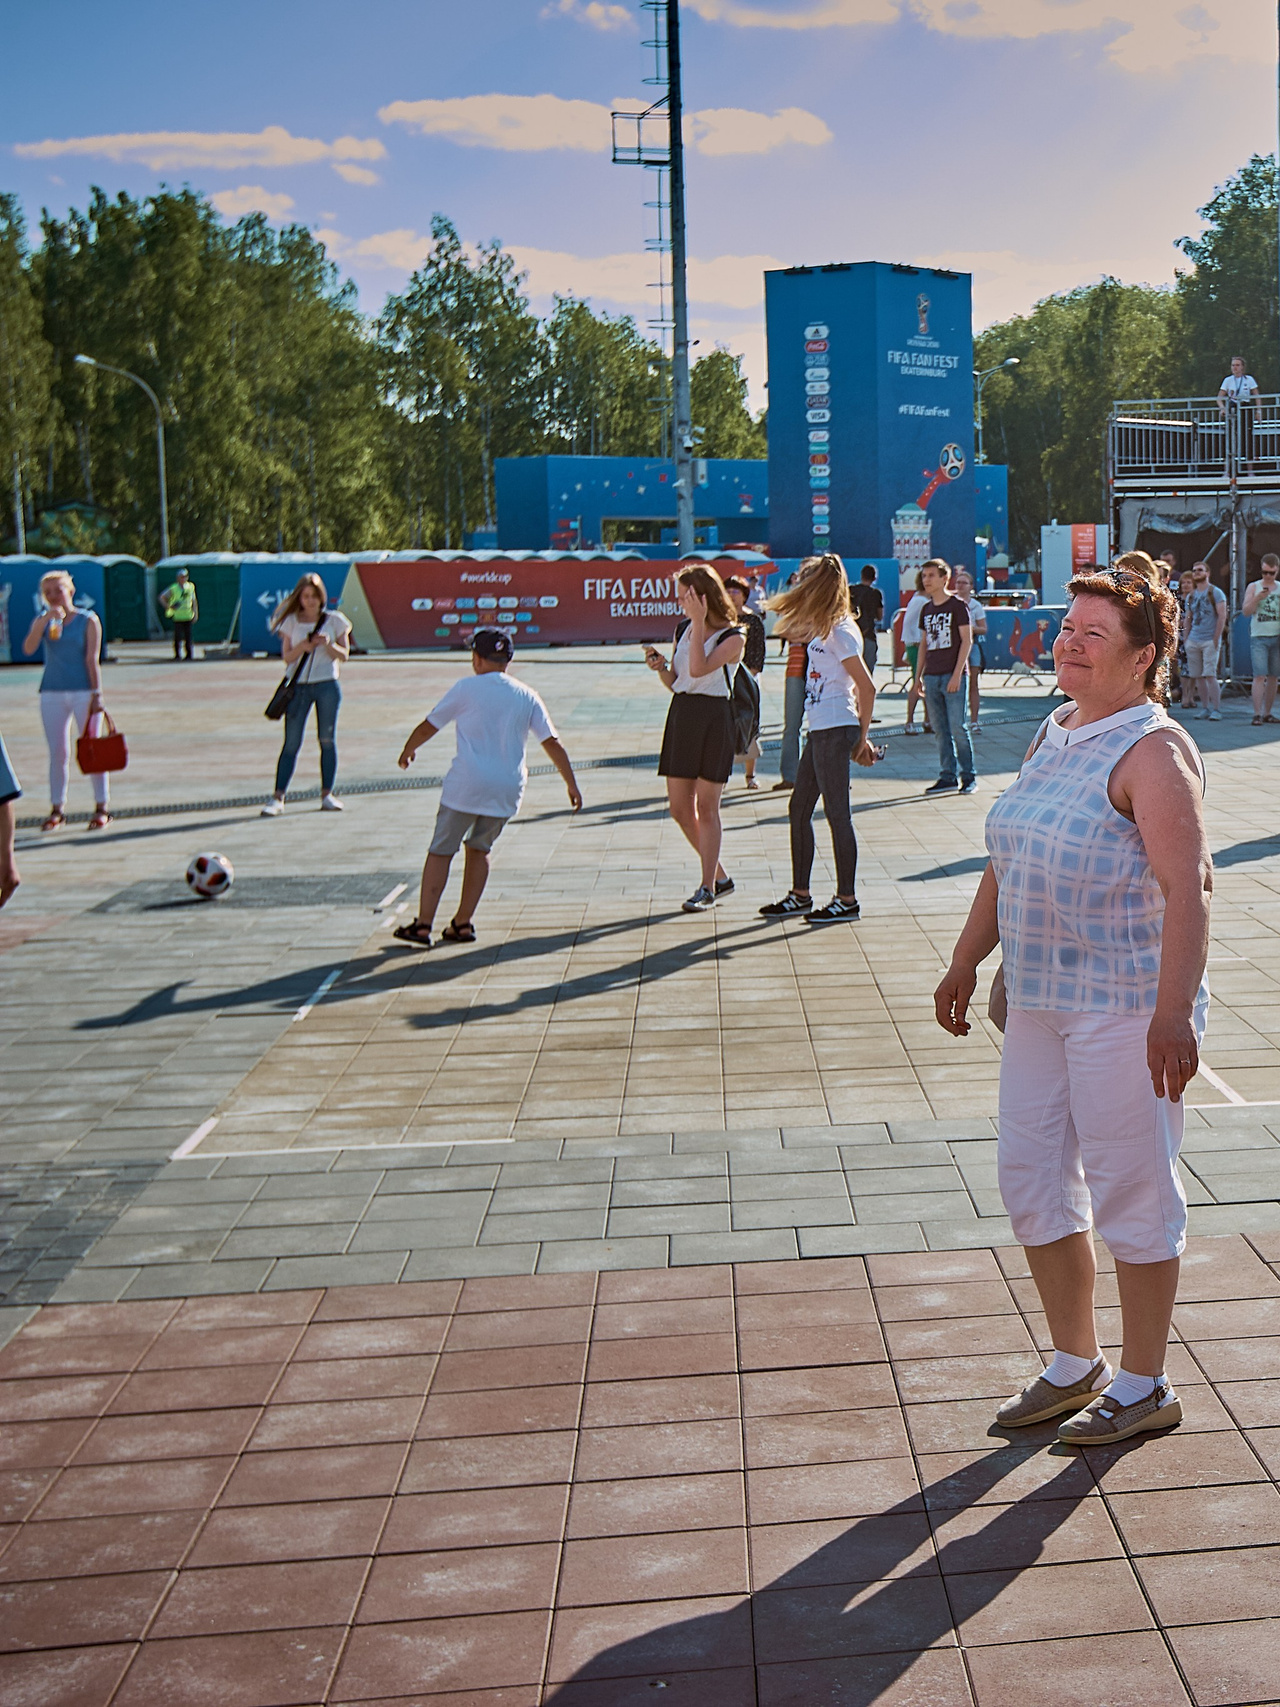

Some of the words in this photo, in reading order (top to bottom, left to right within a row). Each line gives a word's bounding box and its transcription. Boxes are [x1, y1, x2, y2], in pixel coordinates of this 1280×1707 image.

[887, 350, 910, 365] FIFA
[911, 353, 932, 367] FAN
[933, 355, 960, 369] FEST
[900, 365, 948, 378] EKATERINBURG
[810, 412, 826, 420] VISA
[898, 404, 951, 417] #FIFAFanFest
[459, 571, 513, 586] #worldcup
[584, 578, 627, 600] FIFA
[630, 578, 671, 599] FAN
[610, 602, 686, 617] EKATERINBU
